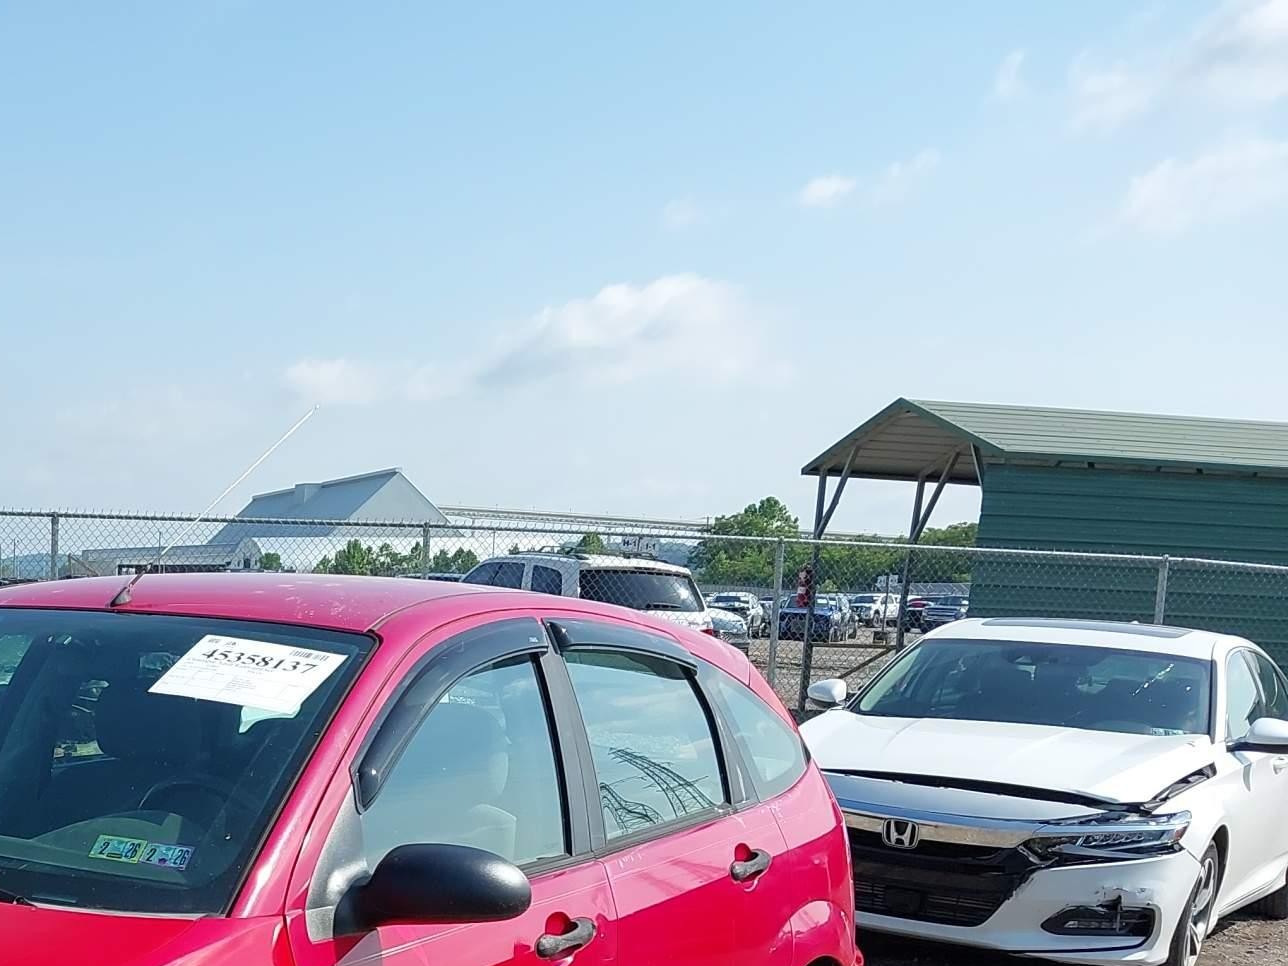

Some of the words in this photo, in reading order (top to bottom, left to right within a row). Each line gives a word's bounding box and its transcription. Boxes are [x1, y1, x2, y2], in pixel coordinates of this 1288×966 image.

[202, 649, 318, 674] 45358137
[99, 841, 110, 855] 2
[125, 842, 140, 859] 26
[146, 848, 157, 861] 2
[173, 849, 189, 865] 26
